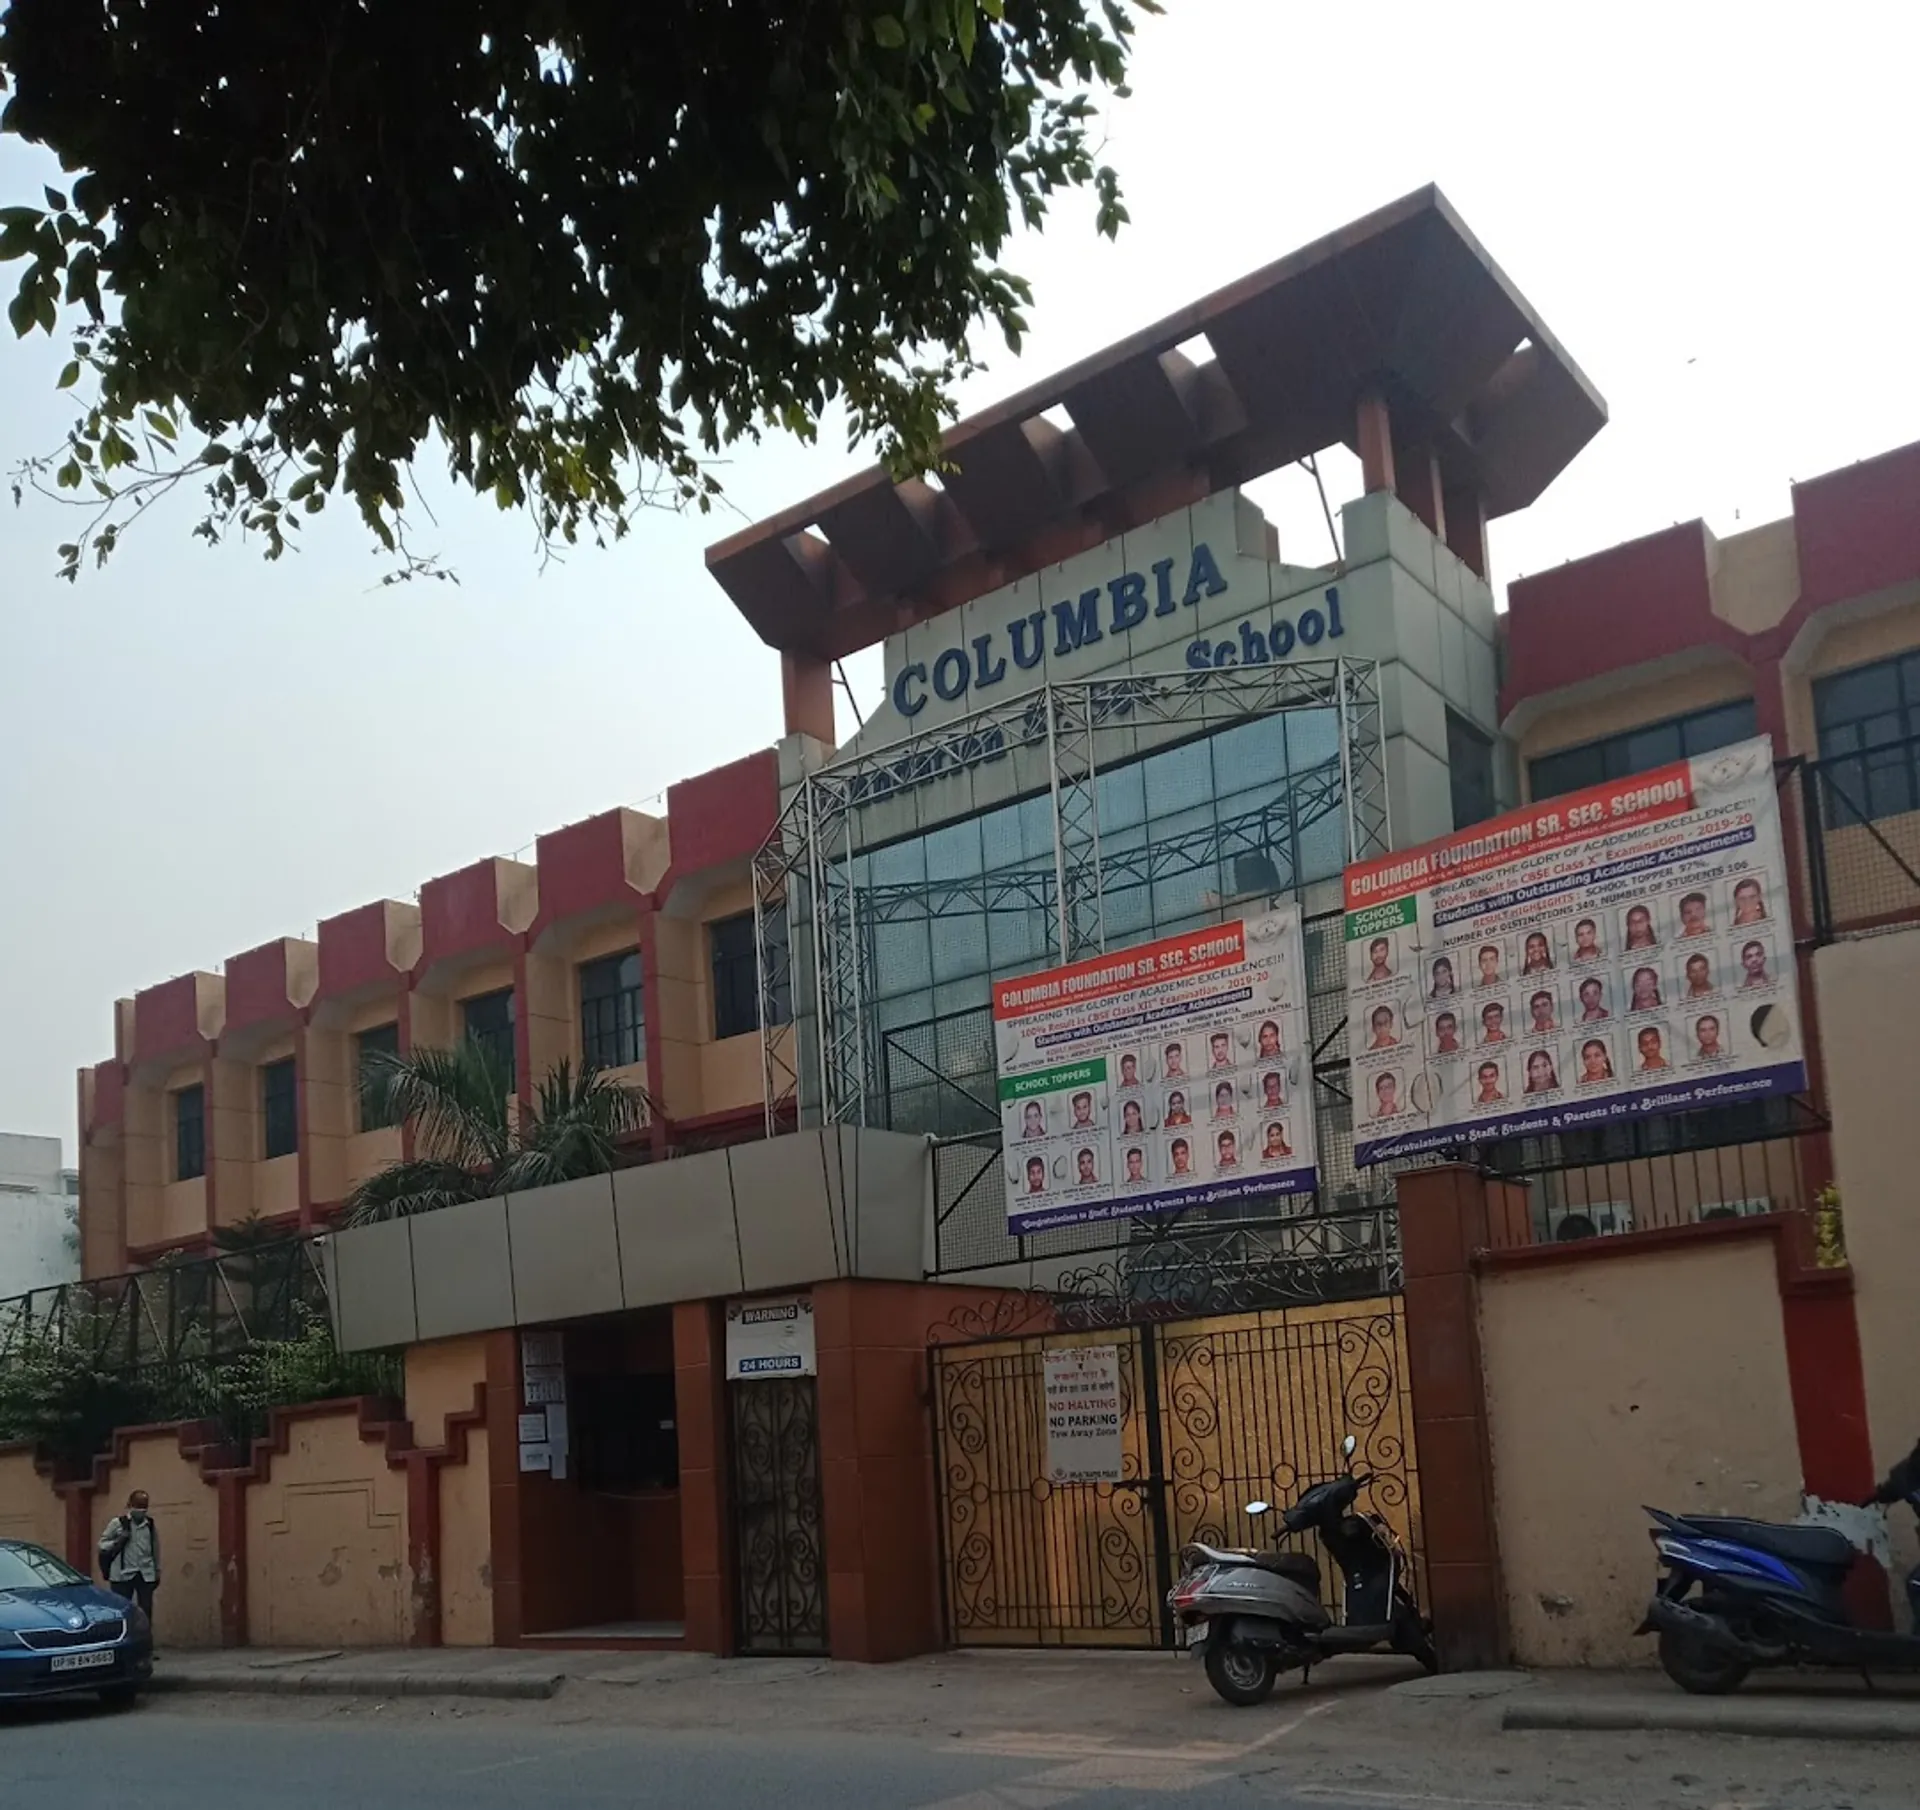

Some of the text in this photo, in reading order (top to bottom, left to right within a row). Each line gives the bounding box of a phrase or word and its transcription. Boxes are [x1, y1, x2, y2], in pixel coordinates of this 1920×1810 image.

[892, 543, 1228, 717] COLUMBIA
[1185, 587, 1345, 688] School
[1351, 857, 1428, 896] COLUMBIA
[1431, 822, 1532, 869] FOUNDATION
[1537, 813, 1564, 836] SR.
[1568, 801, 1608, 827] SEC.
[1611, 778, 1687, 815] SCHOOL
[1469, 881, 1505, 901] Result
[1520, 869, 1549, 885] CBSE
[1553, 859, 1584, 874] Class
[1606, 833, 1684, 861] Examination
[1698, 812, 1752, 836] 2019-20
[1429, 871, 1493, 897] SPREADING
[1495, 864, 1519, 877] THE
[1520, 851, 1560, 870] GLORY
[1564, 845, 1580, 857] OF
[1583, 829, 1649, 852] ACADEMIC
[1435, 903, 1486, 923] Students
[1489, 894, 1514, 908] with
[1517, 873, 1592, 899] Outstanding
[1593, 855, 1655, 880] Academic
[1658, 829, 1753, 862] Achievements
[1586, 880, 1627, 898] SCHOOL
[1631, 869, 1674, 884] TOPPER
[1353, 914, 1405, 937] TOPPERS
[1355, 903, 1401, 922] SCHOOL
[1442, 929, 1483, 947] NUMBER
[1485, 926, 1497, 937] OF
[1500, 906, 1574, 931] DISTINCTIONS
[1601, 887, 1647, 905] NUMBER
[1649, 881, 1664, 893] OF
[1667, 868, 1724, 888] STUDENTS
[1002, 981, 1060, 1008] COLUMBIA
[1062, 963, 1136, 994] FOUNDATION
[1138, 957, 1158, 975] SR.
[1160, 949, 1187, 969] SEC.
[1189, 935, 1241, 961] SCHOOL
[1007, 1010, 1063, 1028] SPREADING
[1066, 1004, 1084, 1015] THE
[1087, 995, 1121, 1010] GLORY
[1123, 992, 1136, 1002] OF
[1139, 978, 1195, 998] ACADEMIC
[1036, 1032, 1073, 1047] Students
[1093, 1016, 1144, 1034] Outstanding
[1145, 1002, 1188, 1020] Academic
[1189, 989, 1250, 1009] Achievements
[1048, 1021, 1076, 1033] Result
[1112, 1006, 1136, 1018] Class
[1160, 986, 1218, 1006] Examination
[1015, 1068, 1091, 1092] SCHOOL TOPPERS
[1373, 1135, 1452, 1158] Congratulations
[1455, 1133, 1465, 1142] to
[1502, 1116, 1548, 1136] Students
[1551, 1117, 1561, 1127] &
[1563, 1107, 1608, 1124] Parents
[1610, 1103, 1626, 1114] for
[1640, 1091, 1692, 1111] Brilliant
[1694, 1078, 1772, 1101] Performance
[1242, 1179, 1295, 1196] Performance
[745, 1306, 795, 1322] WARNING
[742, 1357, 799, 1371] 24 HOURS
[1049, 1398, 1117, 1412] NO HALTING
[1050, 1414, 1117, 1428] NO PARKING
[1070, 1429, 1093, 1439] Away
